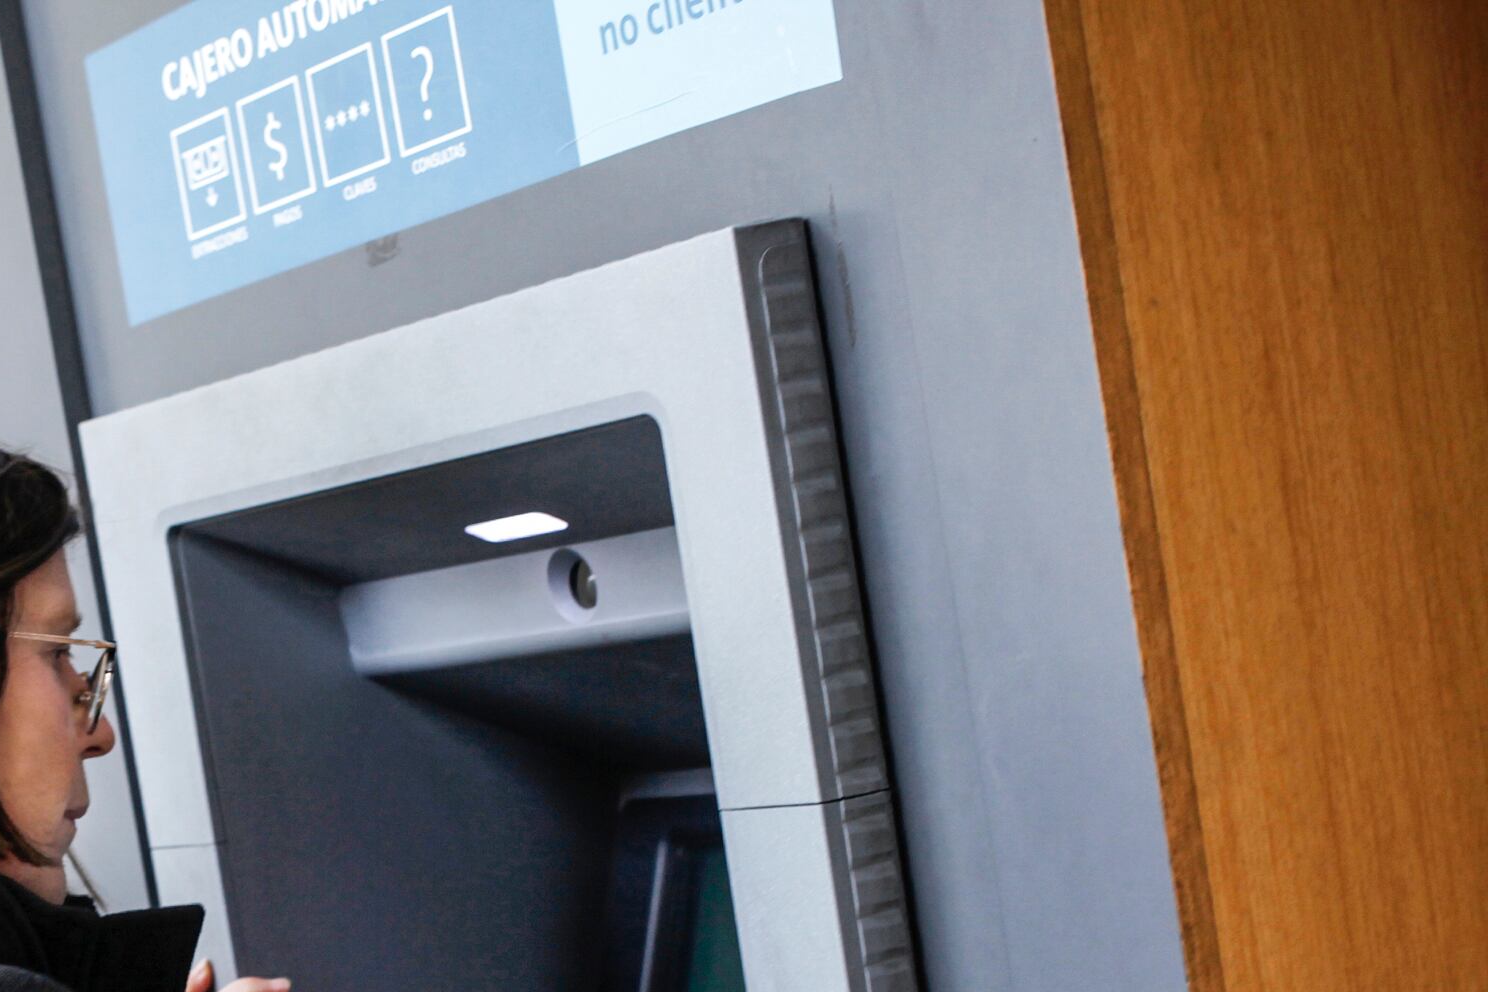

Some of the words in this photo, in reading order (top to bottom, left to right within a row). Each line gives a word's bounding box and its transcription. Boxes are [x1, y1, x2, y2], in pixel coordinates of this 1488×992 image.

[161, 28, 253, 100] CAJERO
[257, 0, 385, 59] AUTOM
[599, 14, 639, 55] no
